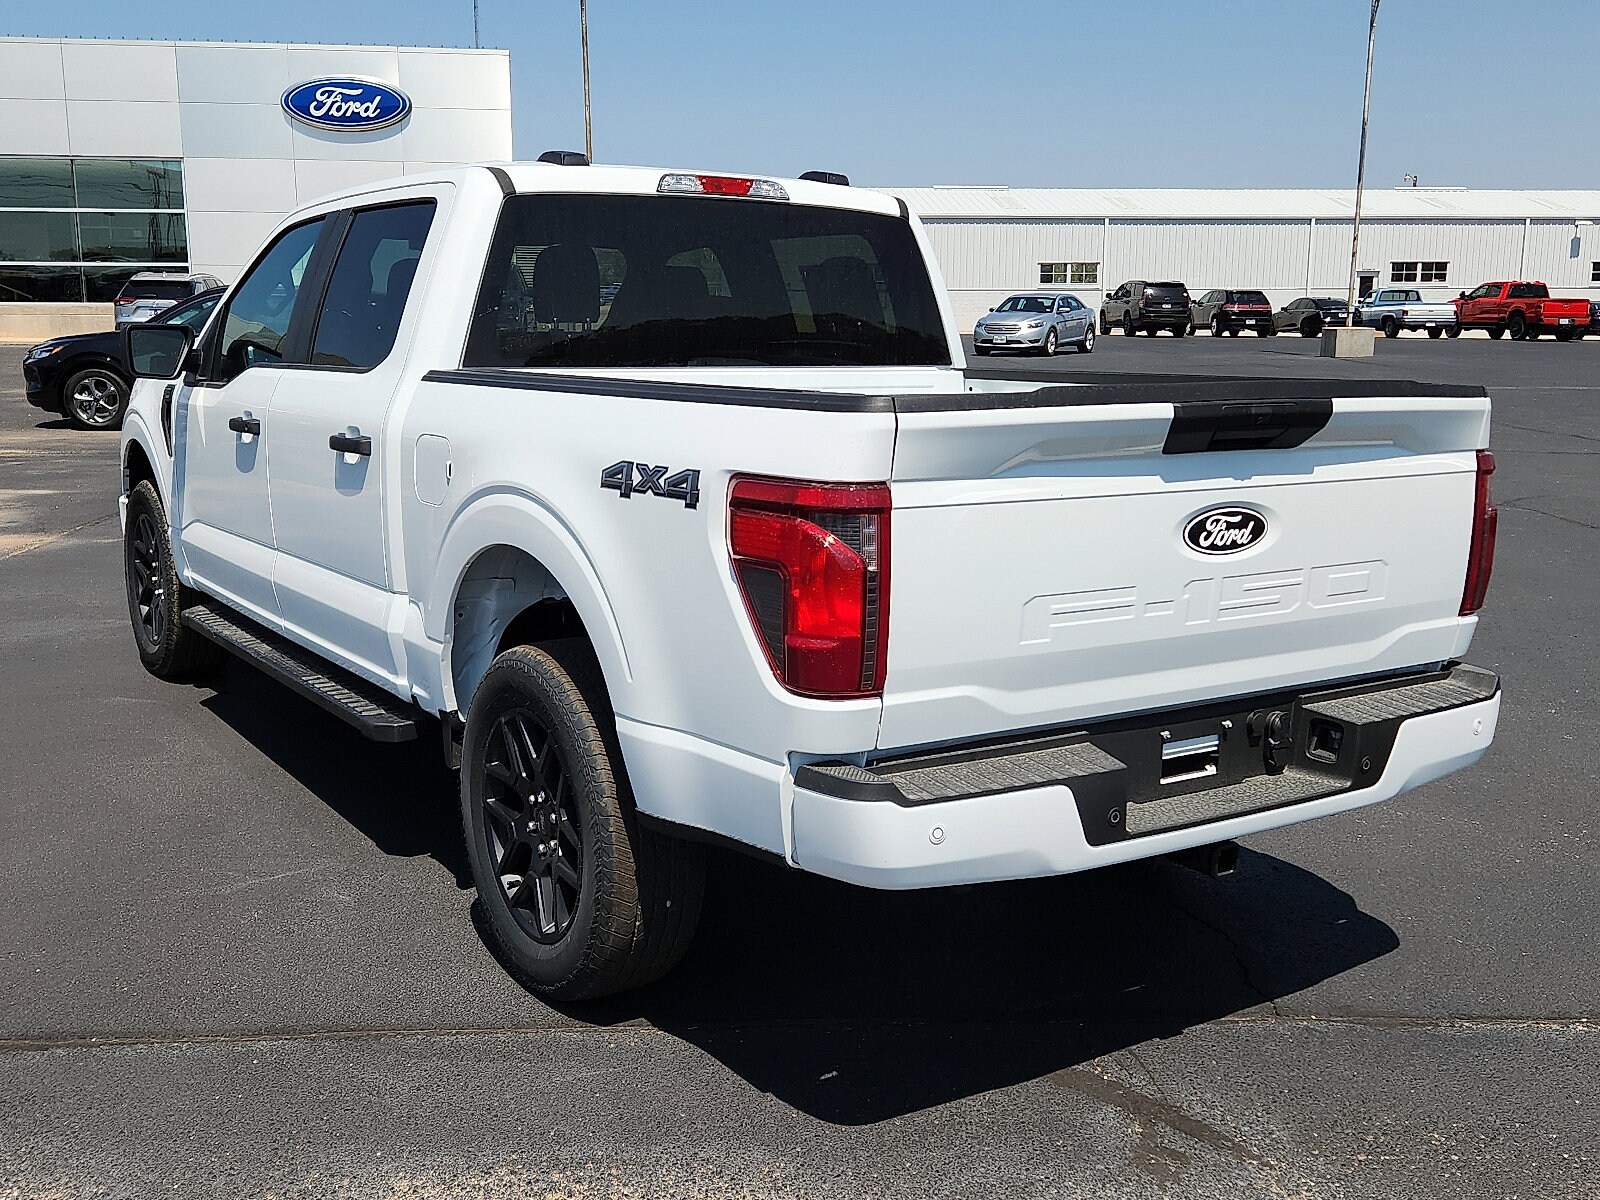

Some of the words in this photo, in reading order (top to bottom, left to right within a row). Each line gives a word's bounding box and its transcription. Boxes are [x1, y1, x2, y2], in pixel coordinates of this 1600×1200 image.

[309, 86, 381, 117] Ford
[1199, 514, 1254, 547] Ford
[1019, 559, 1388, 645] F-150
